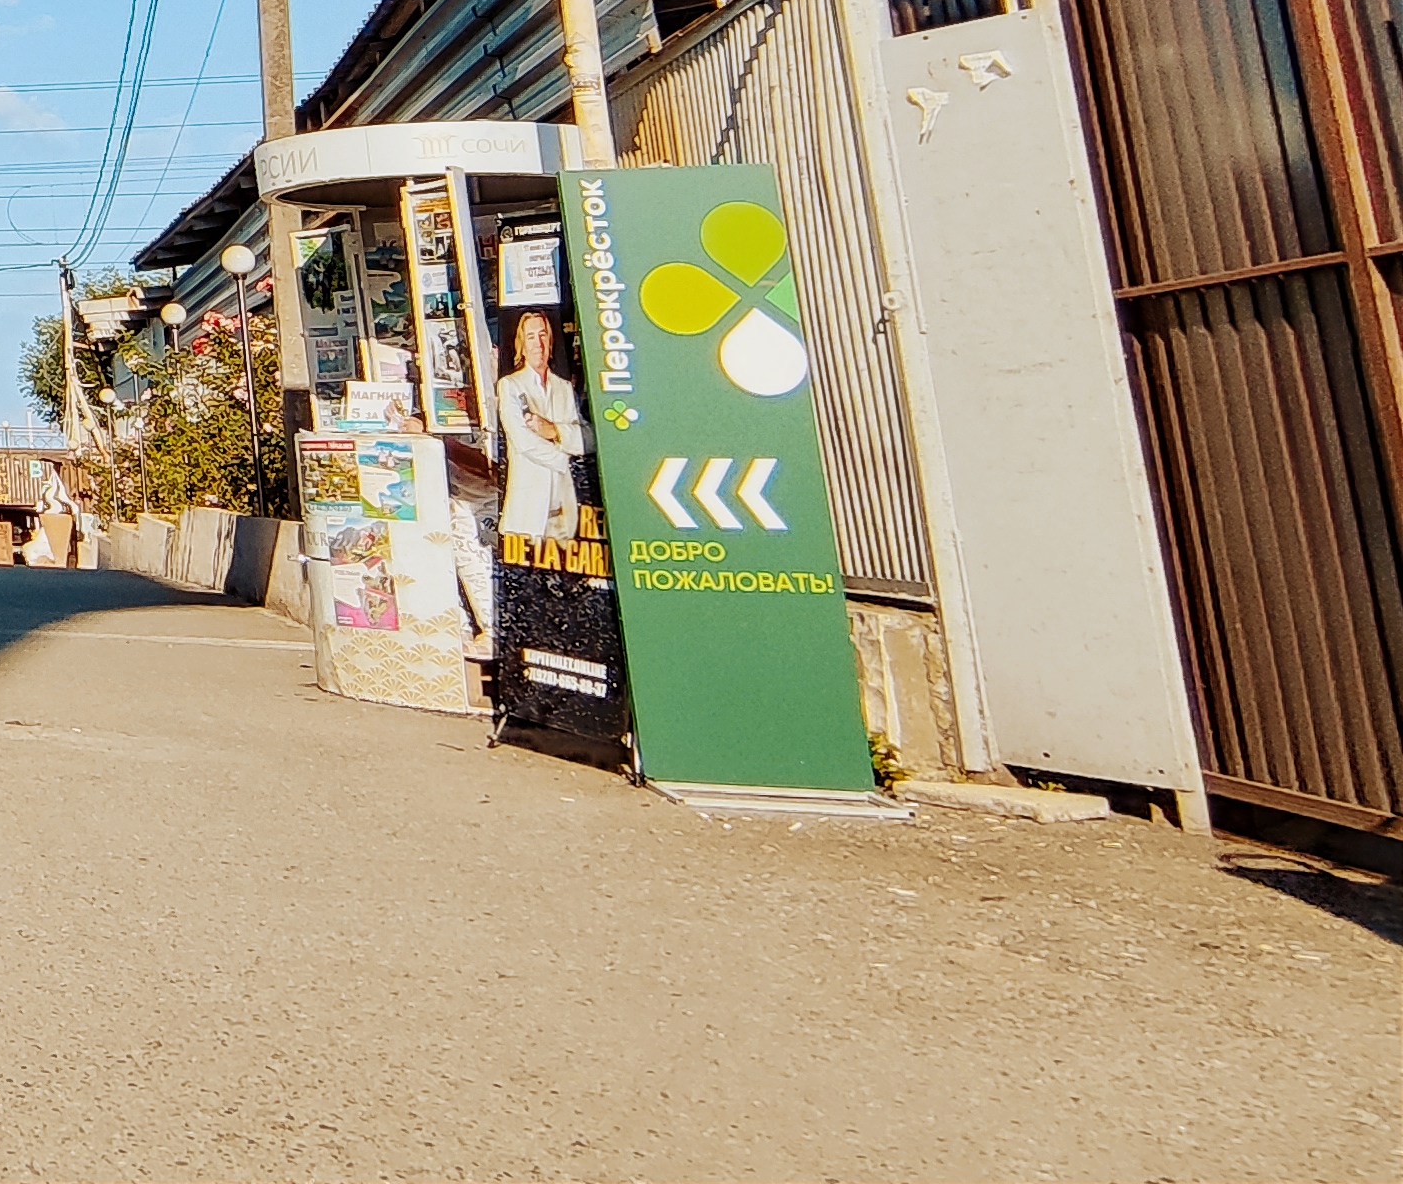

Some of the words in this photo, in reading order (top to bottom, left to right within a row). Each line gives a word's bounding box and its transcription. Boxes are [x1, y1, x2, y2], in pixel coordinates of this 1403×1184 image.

[461, 138, 527, 154] СОЧИ
[580, 179, 635, 393] Перекрёсток
[350, 390, 412, 401] МАГНИТЫ
[351, 408, 361, 418] 5
[503, 532, 531, 567] DE
[533, 537, 562, 571] LA
[629, 540, 727, 563] ДОБРО
[632, 569, 835, 594] ПОЖАЛОВАТЬ!
